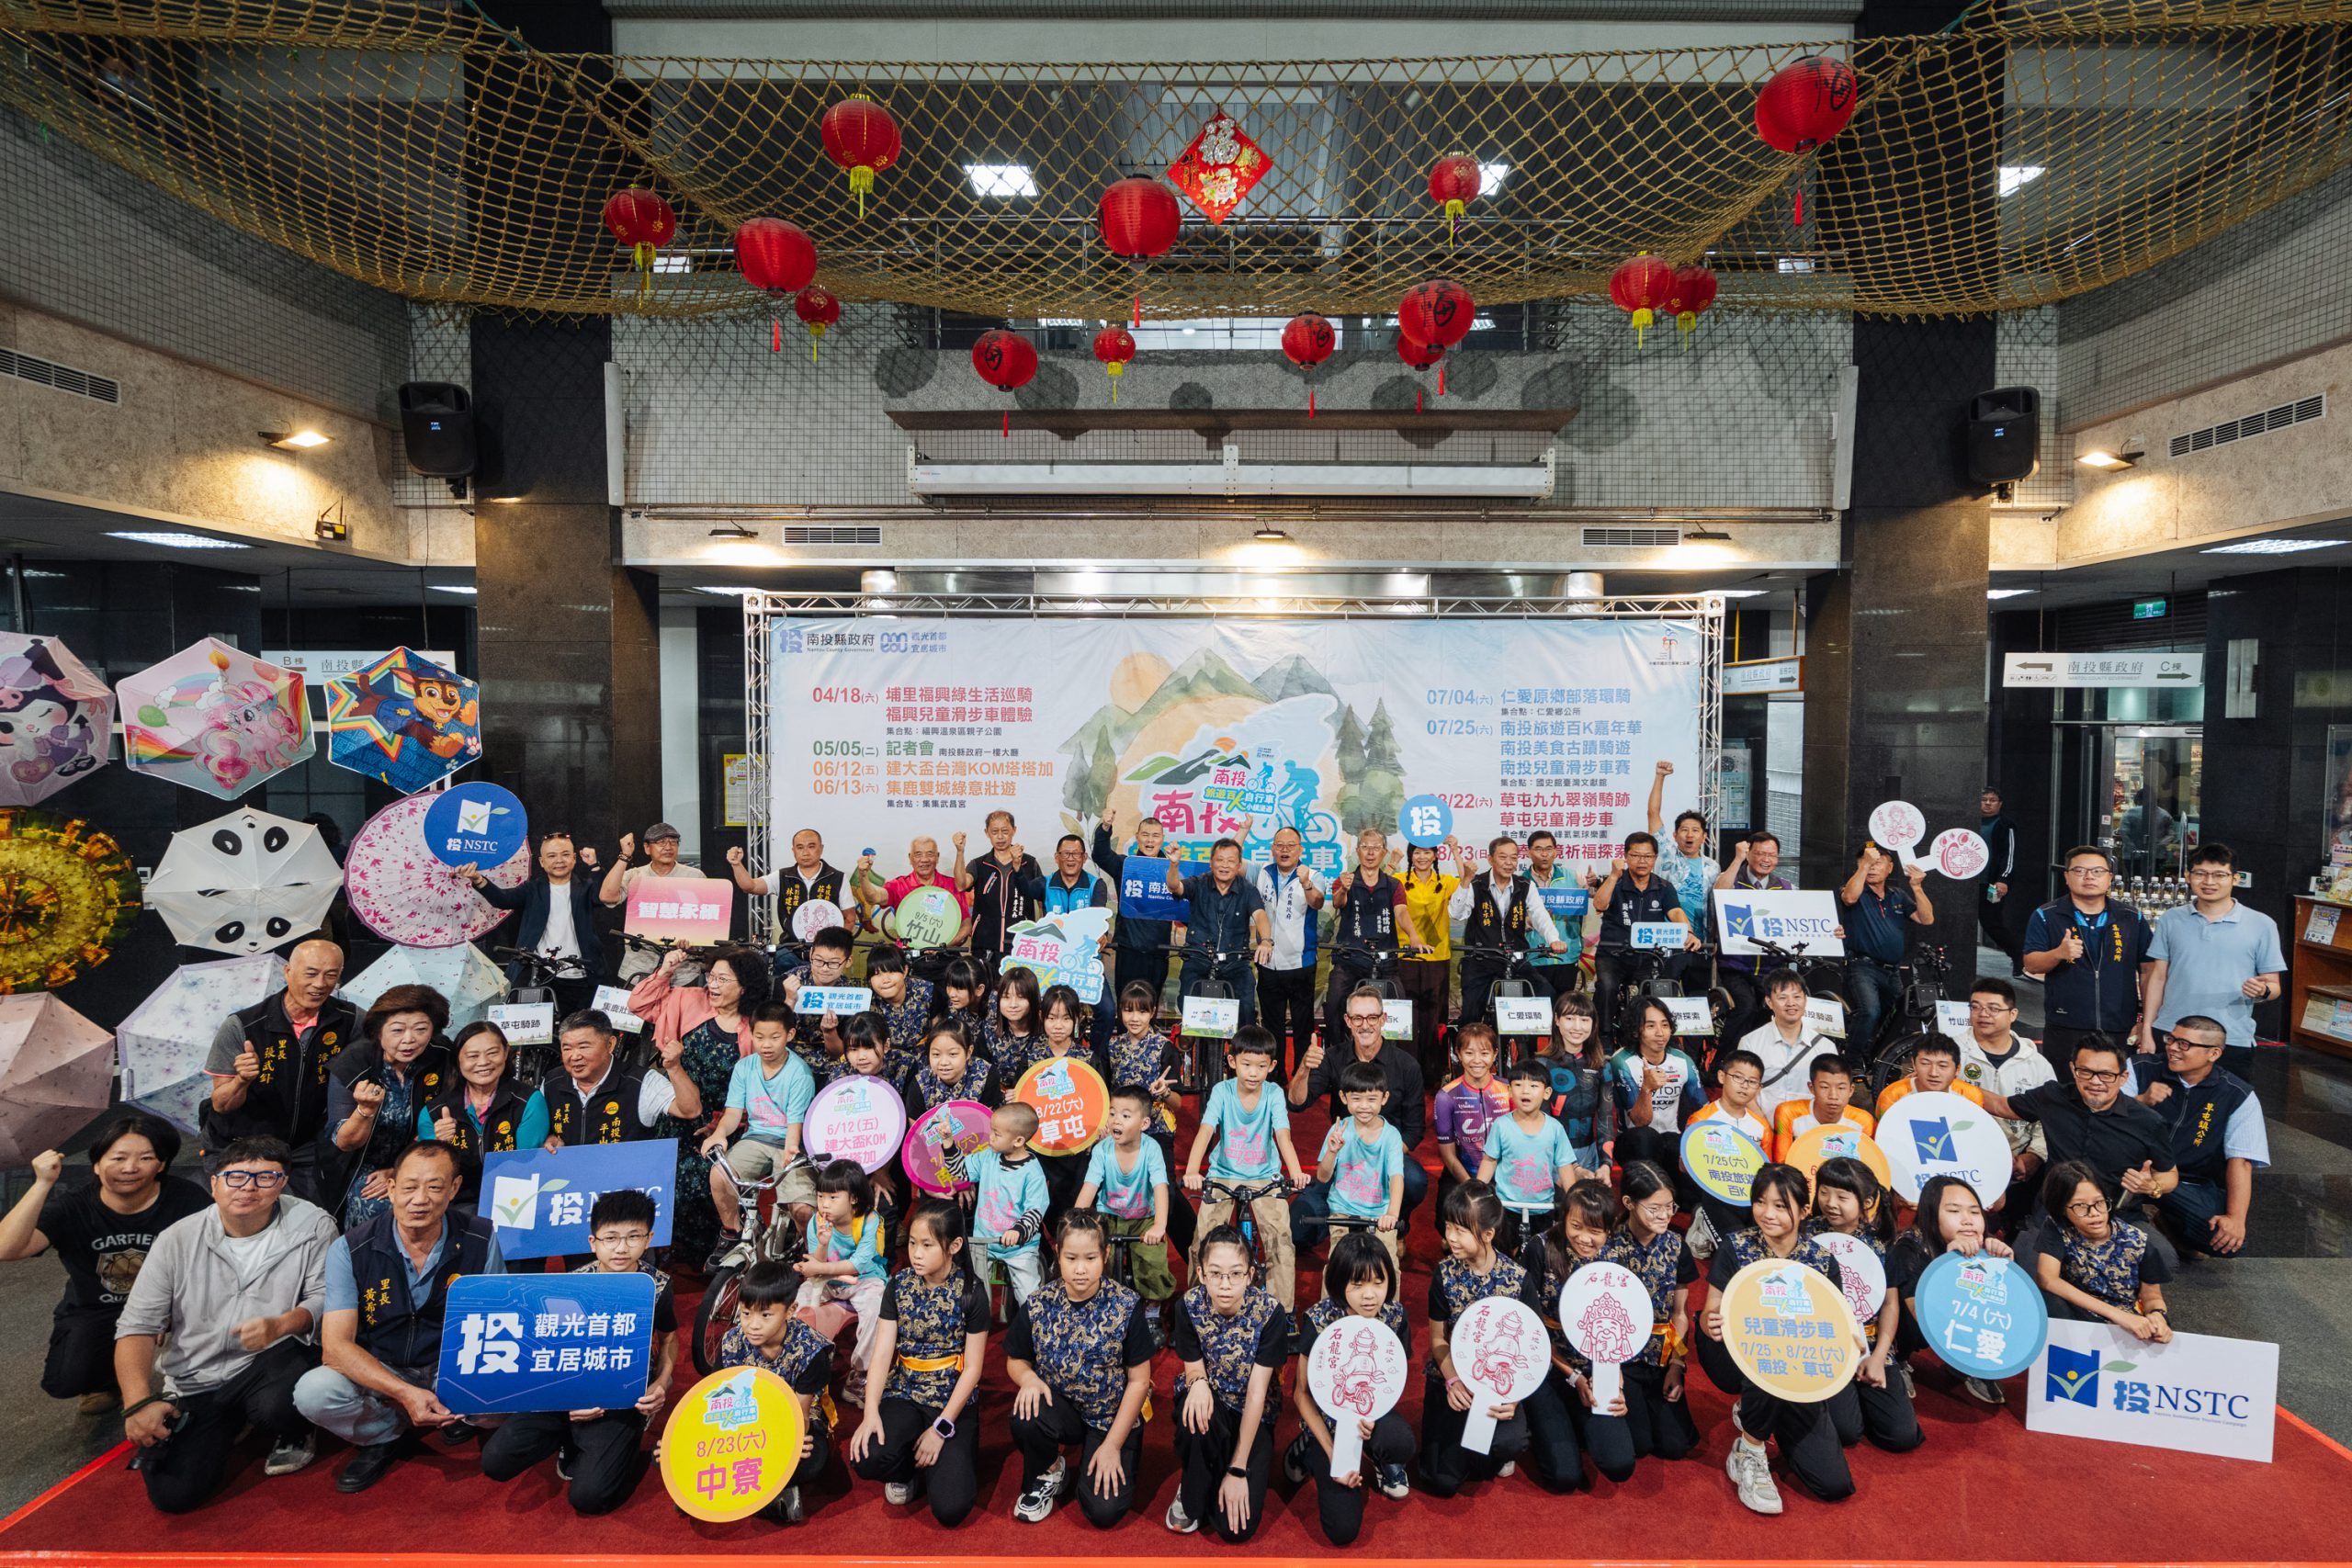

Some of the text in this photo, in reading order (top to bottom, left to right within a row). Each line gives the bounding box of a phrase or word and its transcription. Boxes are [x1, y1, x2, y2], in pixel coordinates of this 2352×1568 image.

[807, 633, 875, 647] 南投縣政府
[322, 658, 366, 671] 南投縣
[2068, 661, 2143, 672] 南投縣政府
[812, 686, 1033, 705] 04/18(六) 埔里福興綠生活巡騎
[1427, 688, 1631, 705] 07/04(六) 仁愛原鄉部落環騎
[886, 706, 1033, 723] 福興兒童滑步車體驗
[1427, 720, 1643, 736] 07/25(六) 南投旅遊百K嘉年華
[812, 740, 1020, 758] 05/05(二) 記者會 南投縣政府一樓大廳
[1500, 740, 1631, 756] 南投美食古蹟騎遊
[812, 761, 1054, 778] 06/12(五) 建大盃台灣KOM塔塔加
[1500, 760, 1631, 775] 南投兒童滑步車賽
[1213, 768, 1247, 787] 南投
[812, 780, 1017, 797] 06/13(六) 集鹿雙城綠意壯遊
[1430, 793, 1631, 809] 8/22(六) 草屯九九翠嶺騎跡
[1410, 806, 1442, 837] 投
[1499, 812, 1613, 828] 草屯兒童滑步車
[447, 838, 498, 852] 投 NSTC
[1125, 879, 1144, 898] 投
[914, 911, 944, 929] 9/5(六)
[1762, 918, 1832, 937] 投 NSTC
[906, 919, 942, 946] 竹山
[1637, 928, 1653, 943] 投
[1016, 938, 1059, 964] 南投
[802, 991, 825, 1009] 投
[826, 1001, 862, 1010] 宜居城市
[828, 992, 864, 1001] 觀光首都
[1508, 1011, 1542, 1020] 仁愛環騎
[500, 1019, 541, 1031] 草屯騎跡
[277, 1039, 288, 1061] 里長
[1035, 1097, 1084, 1119] 8/22(六)
[827, 1117, 879, 1135] 6/12(五)
[1039, 1114, 1086, 1145] 草屯
[2193, 1102, 2214, 1146] 草屯鎮公所
[824, 1134, 887, 1153] 建大盃KOM
[1703, 1154, 1748, 1168] 7/25(六)
[1727, 1185, 1747, 1197] 百K
[549, 1192, 584, 1226] 投
[92, 1234, 158, 1250] GARFIE
[379, 1278, 391, 1305] 里長
[1951, 1300, 2012, 1331] 7/4(六)
[534, 1312, 637, 1339] 觀光首都
[1744, 1317, 1836, 1339] 兒童滑步車
[457, 1312, 523, 1375] 投
[1944, 1319, 2007, 1364] 仁愛
[529, 1346, 634, 1373] 宜居城市
[1757, 1359, 1835, 1379] 南投、草屯
[710, 1397, 734, 1411] 南投
[2113, 1380, 2249, 1419] 投 NSTC
[696, 1428, 766, 1458] 8/23(六)
[696, 1457, 763, 1501] 中寮
